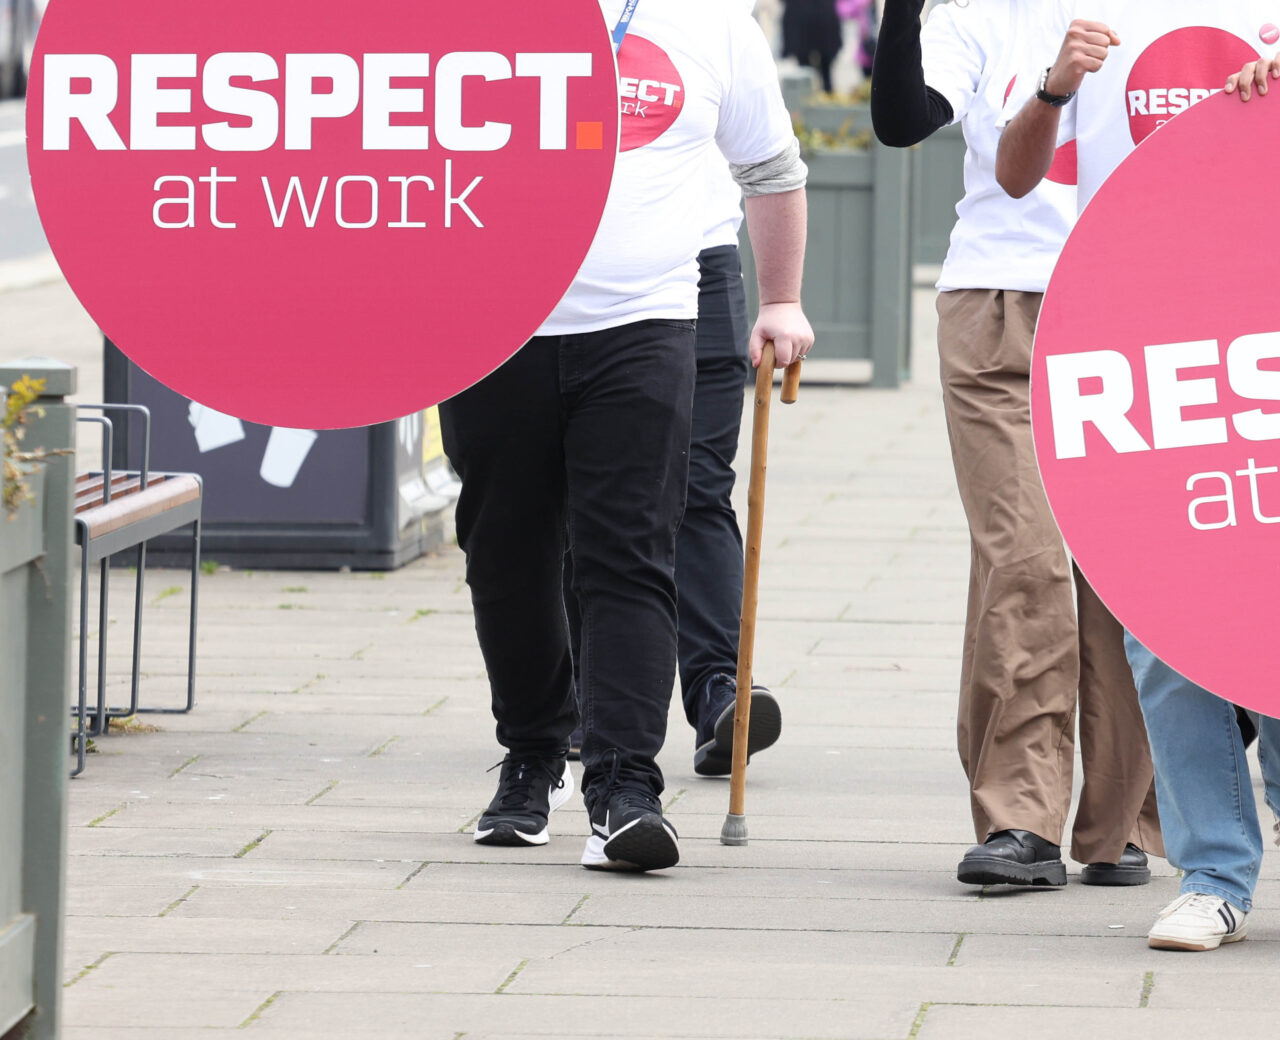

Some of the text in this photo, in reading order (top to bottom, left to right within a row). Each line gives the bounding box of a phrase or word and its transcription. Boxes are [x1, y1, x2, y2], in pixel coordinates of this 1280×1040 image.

[42, 52, 602, 152] RESPECT.
[619, 77, 681, 108] ECT.
[152, 159, 484, 229] at work
